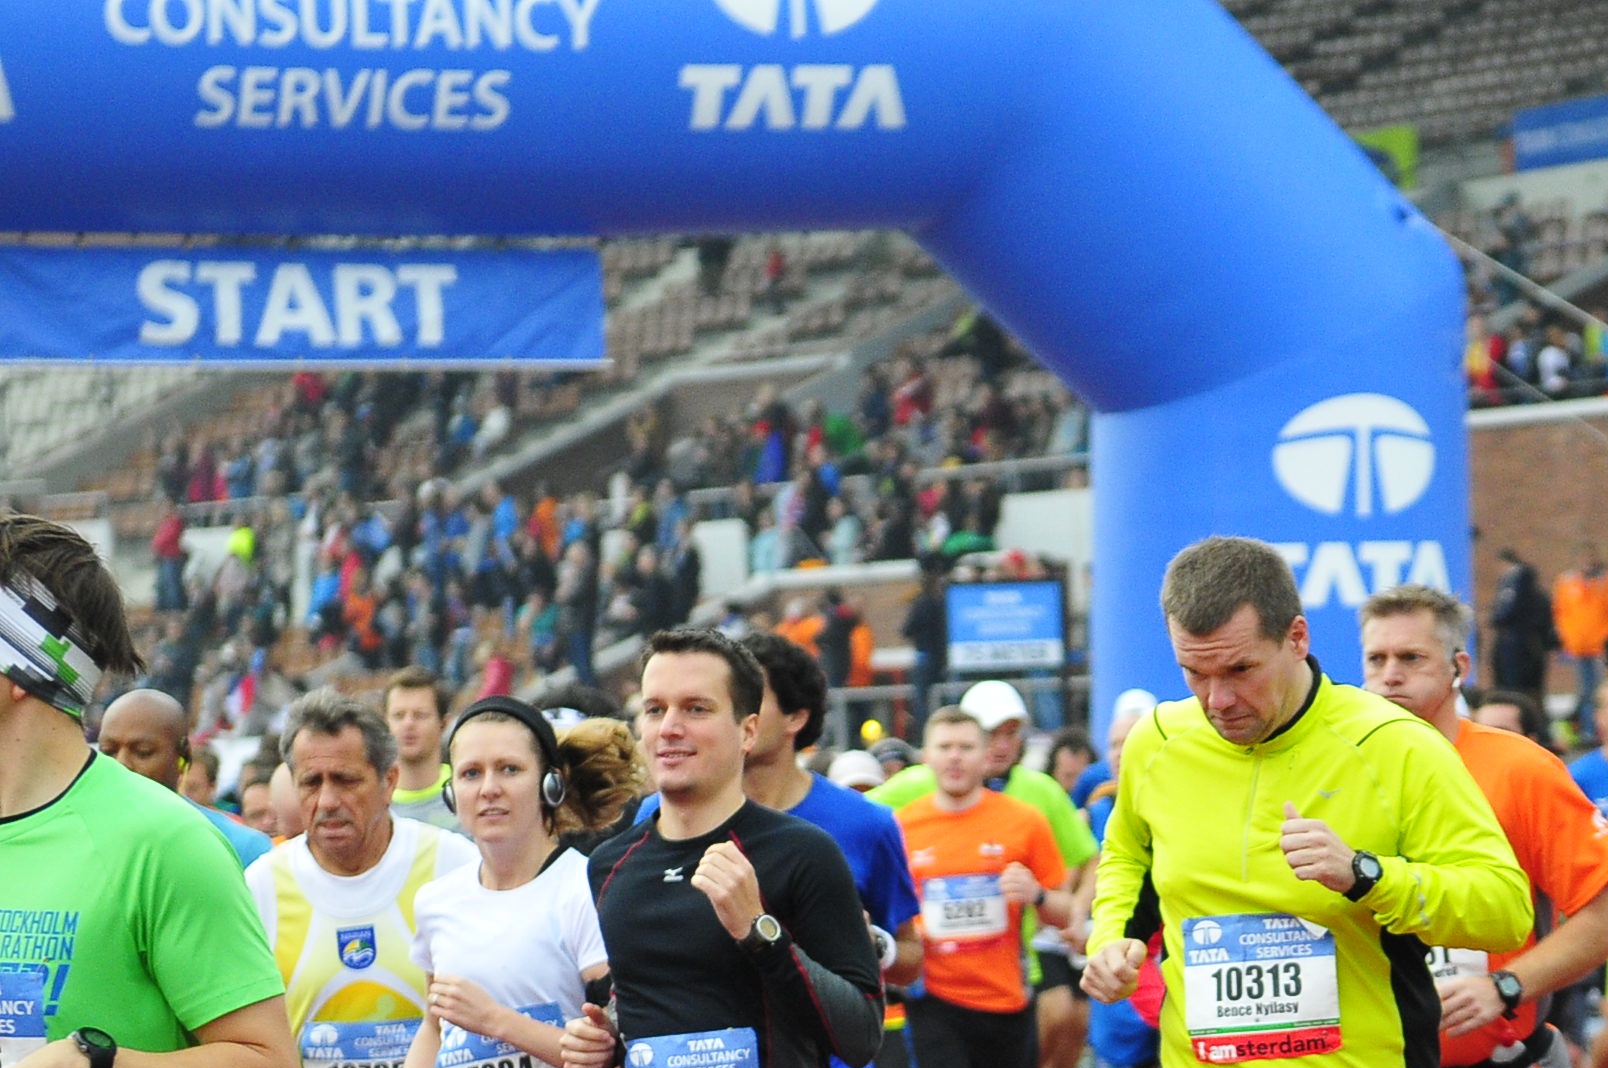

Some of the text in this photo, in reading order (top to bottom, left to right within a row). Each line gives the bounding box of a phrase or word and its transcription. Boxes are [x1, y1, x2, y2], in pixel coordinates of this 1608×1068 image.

[103, 0, 598, 50] CONSULTANCY
[194, 64, 511, 130] SERVICES
[678, 63, 908, 131] TATA
[136, 261, 457, 348] START
[0, 909, 79, 935] OCKHOLM
[1262, 917, 1300, 931] TATA
[1238, 929, 1325, 946] CONSULTAN
[1188, 947, 1231, 964] TATA
[1255, 943, 1313, 960] SERVICES
[1210, 961, 1303, 1002] 10313
[1216, 1003, 1253, 1019] Bence
[305, 1047, 345, 1059] TATA
[687, 1037, 725, 1051] TATA
[439, 1047, 475, 1068] TATA
[666, 1047, 751, 1068] CONSULTANCY
